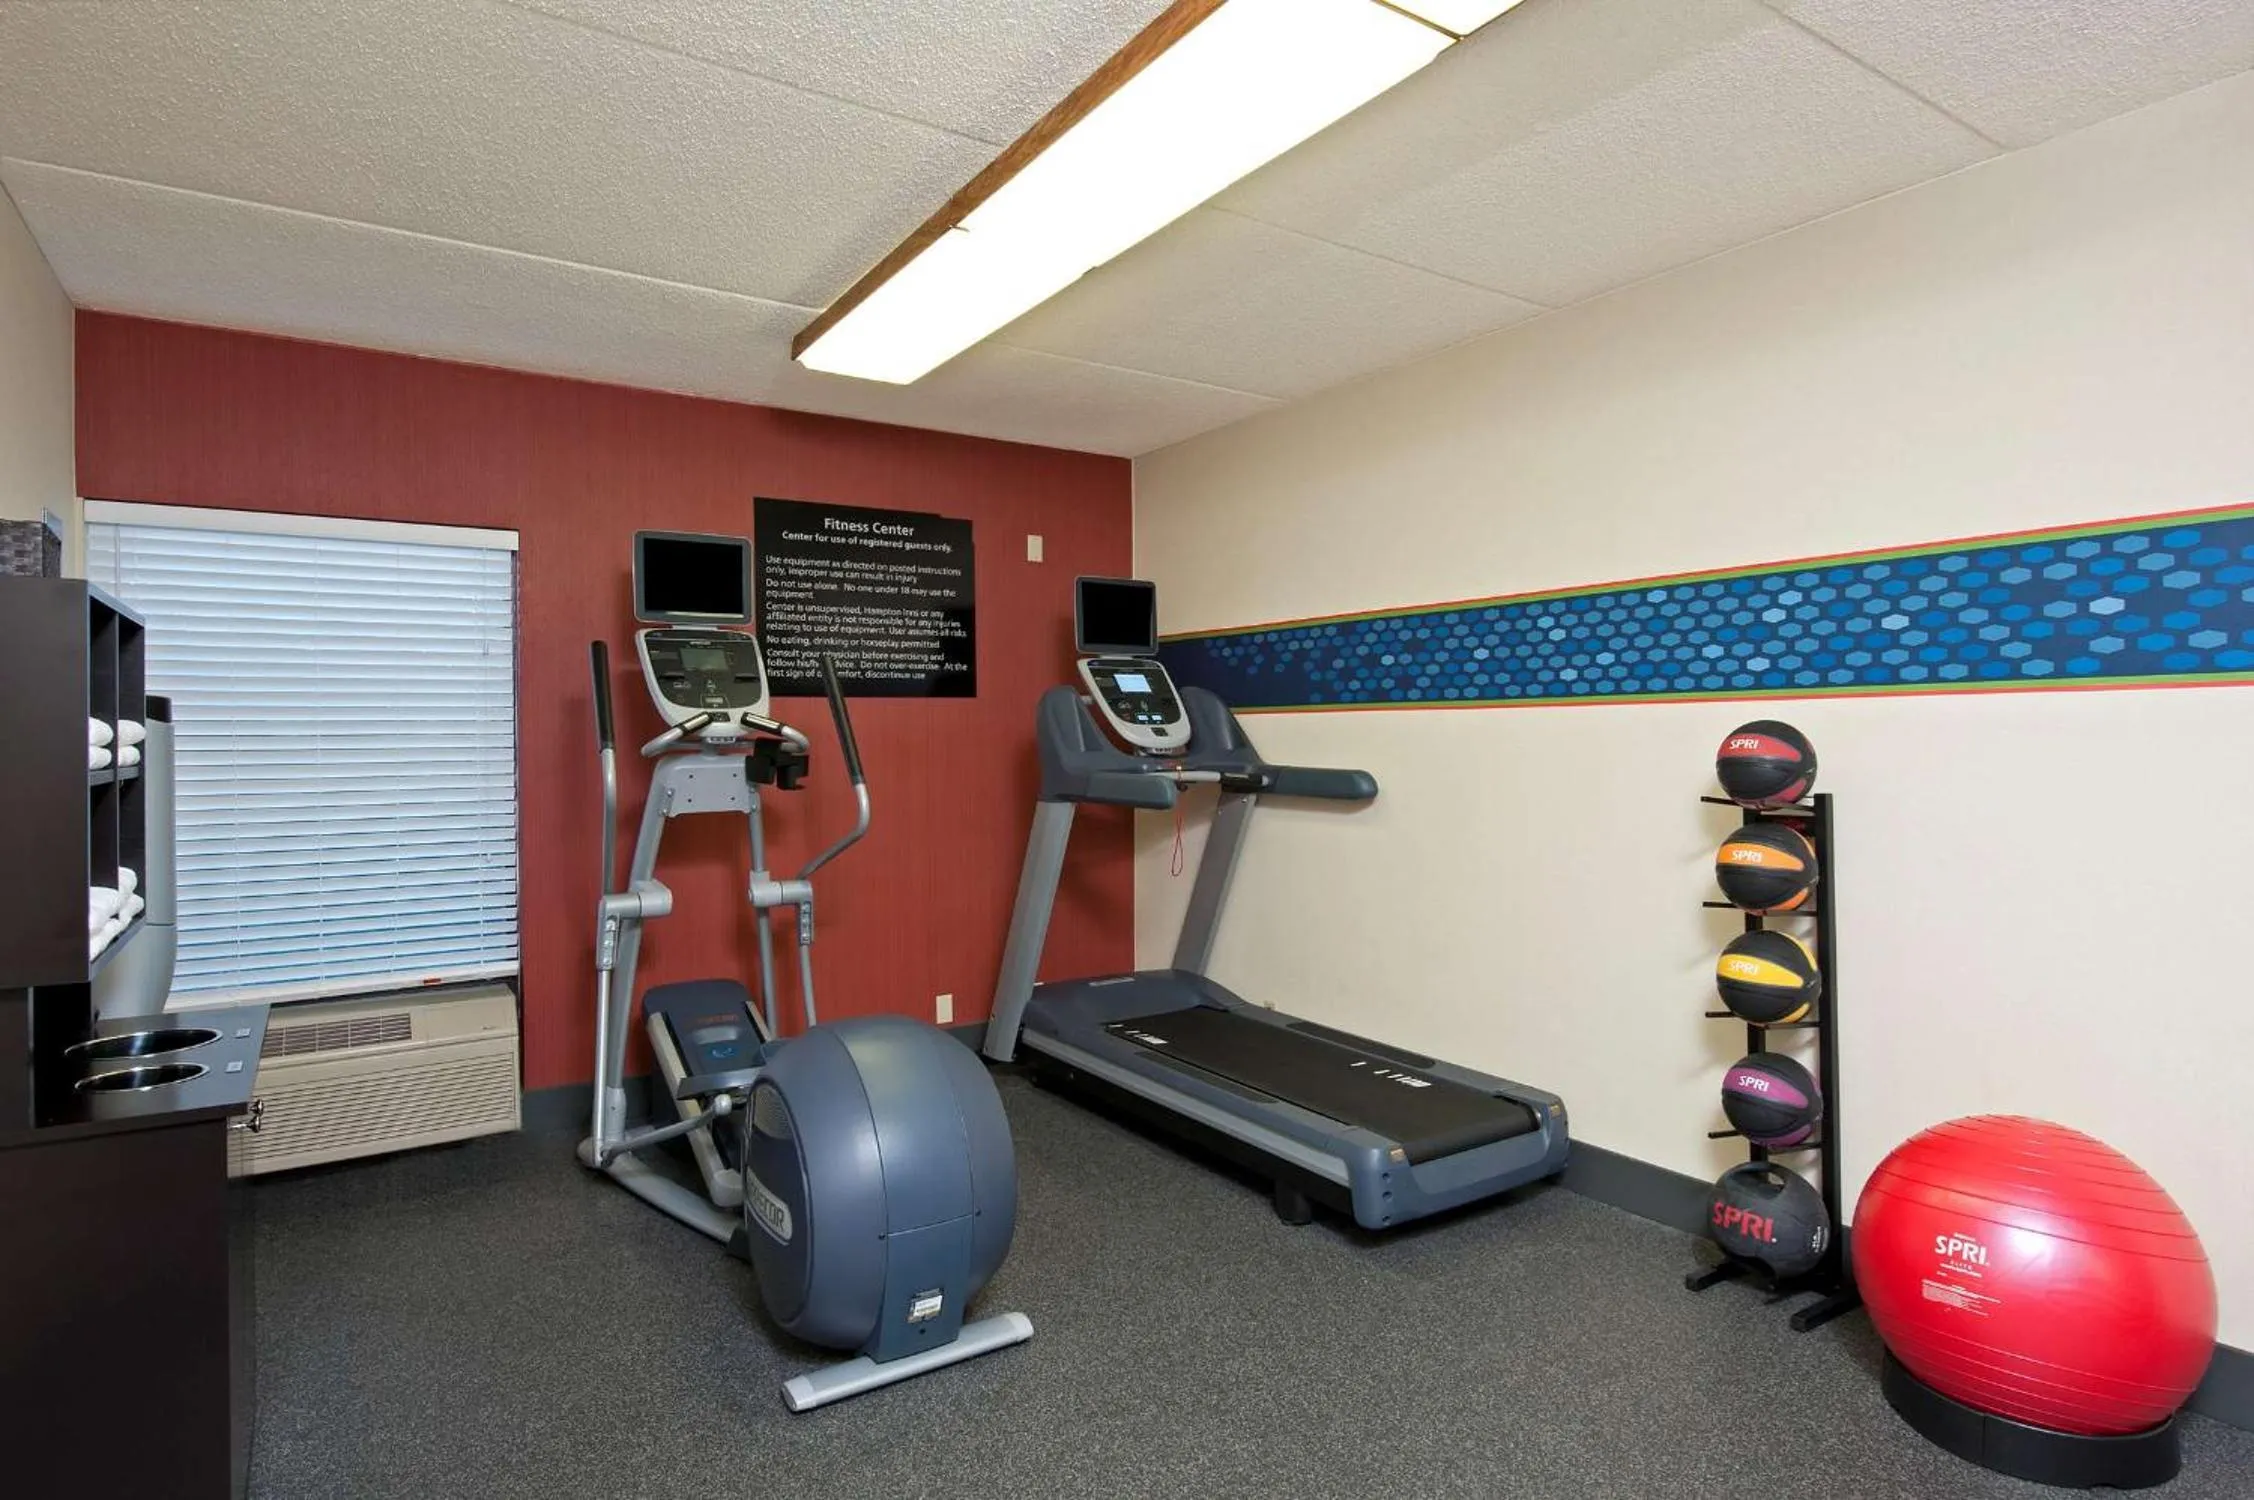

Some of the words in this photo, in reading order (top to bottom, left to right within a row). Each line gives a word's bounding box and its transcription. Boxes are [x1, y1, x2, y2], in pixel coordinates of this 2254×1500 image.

[824, 517, 869, 533] Fitness
[872, 522, 914, 536] Center
[782, 530, 813, 542] Center
[815, 533, 829, 542] for
[831, 536, 846, 544] use
[848, 536, 857, 545] of
[859, 538, 903, 548] registered
[904, 541, 932, 551] guests
[766, 555, 781, 563] Use
[782, 557, 830, 567] equipment
[842, 560, 875, 570] directed
[889, 564, 916, 573] posted
[918, 564, 961, 576] instructions
[788, 567, 827, 578] improper
[845, 571, 860, 579] can
[861, 572, 884, 581] result
[886, 573, 894, 581] in
[766, 578, 779, 587] Do
[781, 580, 796, 588] not
[843, 583, 856, 591] No
[874, 585, 898, 594] under
[901, 586, 910, 594] 18
[911, 588, 928, 597] may
[942, 588, 957, 597] the
[766, 601, 795, 611] Center
[797, 603, 804, 611] is
[766, 621, 800, 633] relating
[802, 623, 812, 631] to
[829, 624, 839, 632] of
[808, 614, 833, 624] entity
[858, 617, 903, 626] responsible
[904, 617, 916, 625] for
[918, 620, 931, 628] any
[766, 634, 780, 643] No
[812, 637, 849, 647] drinking
[860, 638, 899, 649] horseplay
[766, 648, 800, 658] Consult
[801, 650, 821, 659] your
[861, 651, 888, 660] before
[890, 653, 928, 662] exercising
[929, 652, 944, 661] and
[767, 658, 796, 667] follow
[860, 661, 872, 669] Do
[943, 662, 954, 671] At
[954, 663, 968, 671] the
[767, 669, 784, 677] first
[785, 668, 804, 679] sign
[805, 669, 815, 677] of
[864, 671, 911, 679] discontinue
[1729, 738, 1759, 750] SPRI
[1731, 849, 1763, 863] SPRI
[1729, 960, 1759, 976] SPRI
[1738, 1075, 1770, 1092] SPRI
[1712, 1201, 1774, 1243] SPRI
[1934, 1235, 1987, 1266] SPRI
